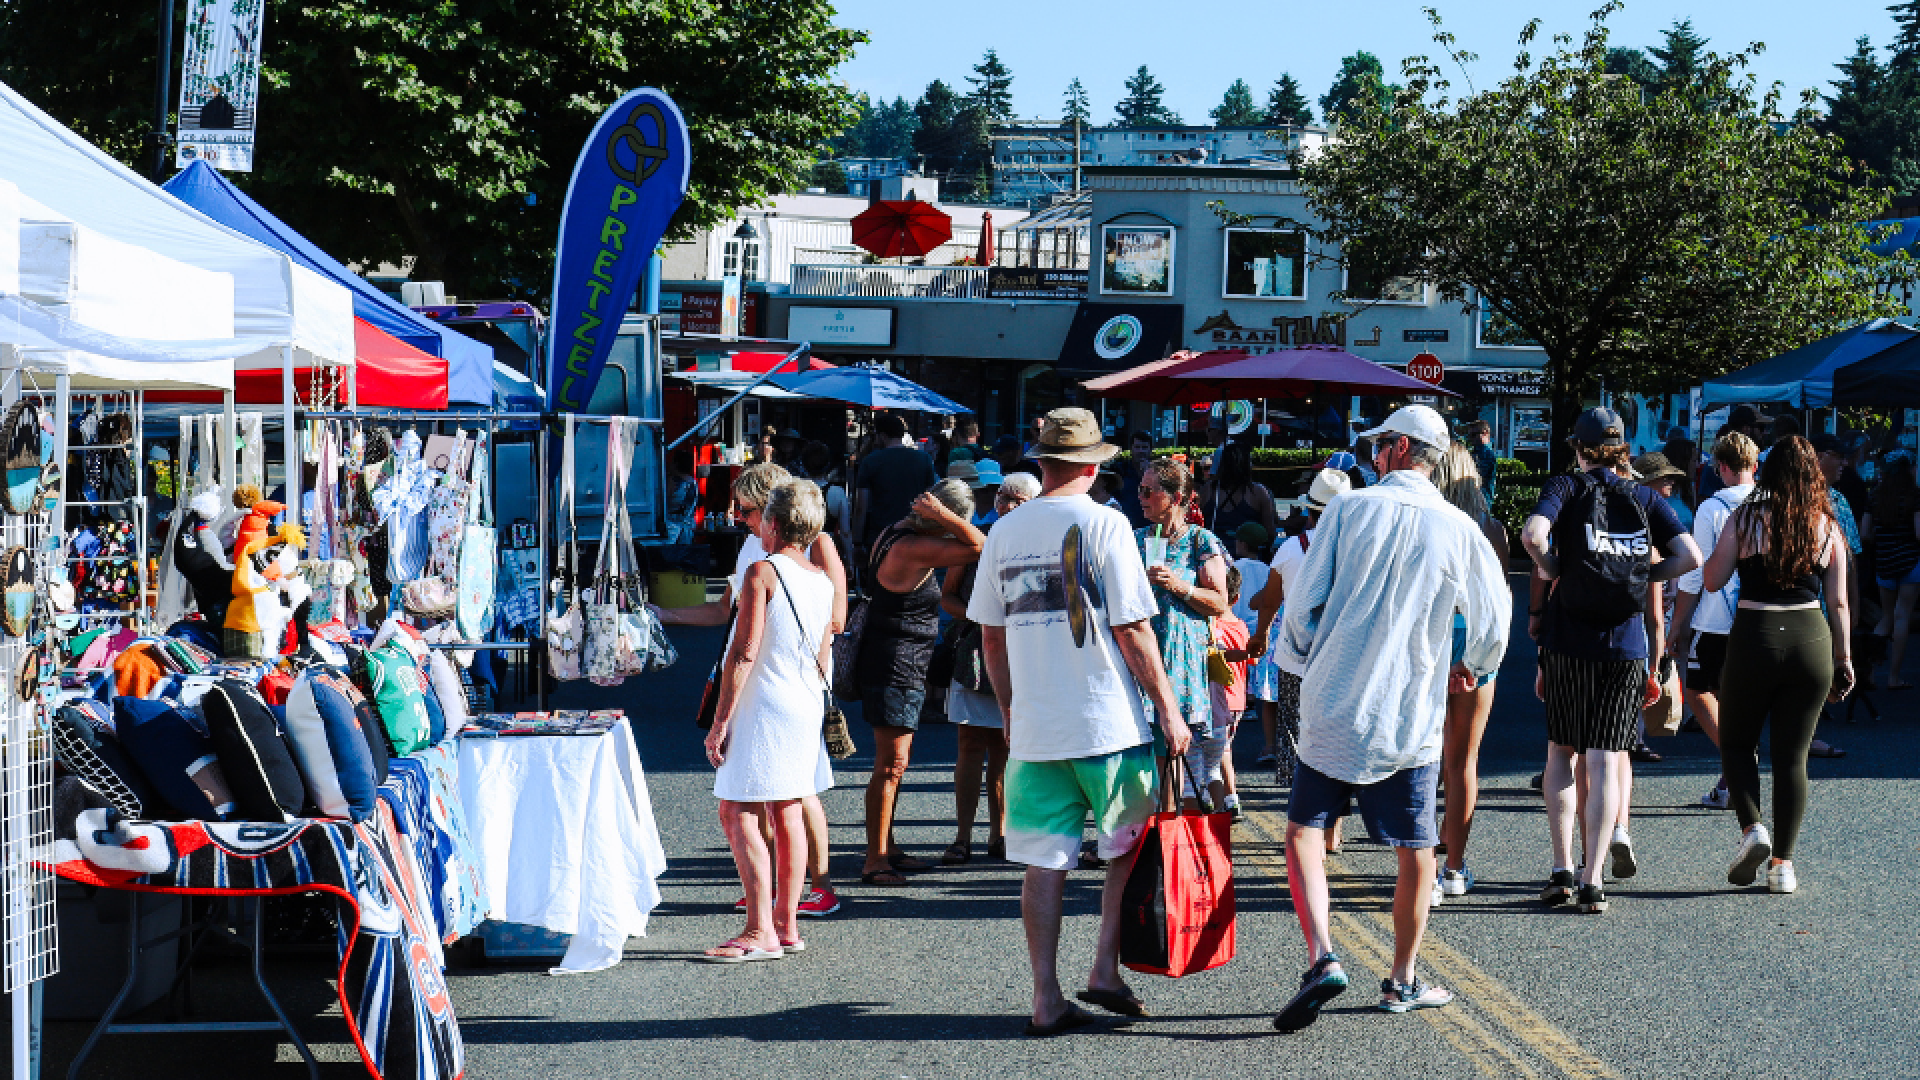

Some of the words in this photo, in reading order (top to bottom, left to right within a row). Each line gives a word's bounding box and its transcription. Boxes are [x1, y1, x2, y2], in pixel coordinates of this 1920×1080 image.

[1213, 330, 1276, 342] BAAN
[1272, 315, 1347, 346] THAI
[1410, 365, 1441, 379] STOP
[1477, 373, 1514, 383] HONEY
[1584, 522, 1649, 557] VANS
